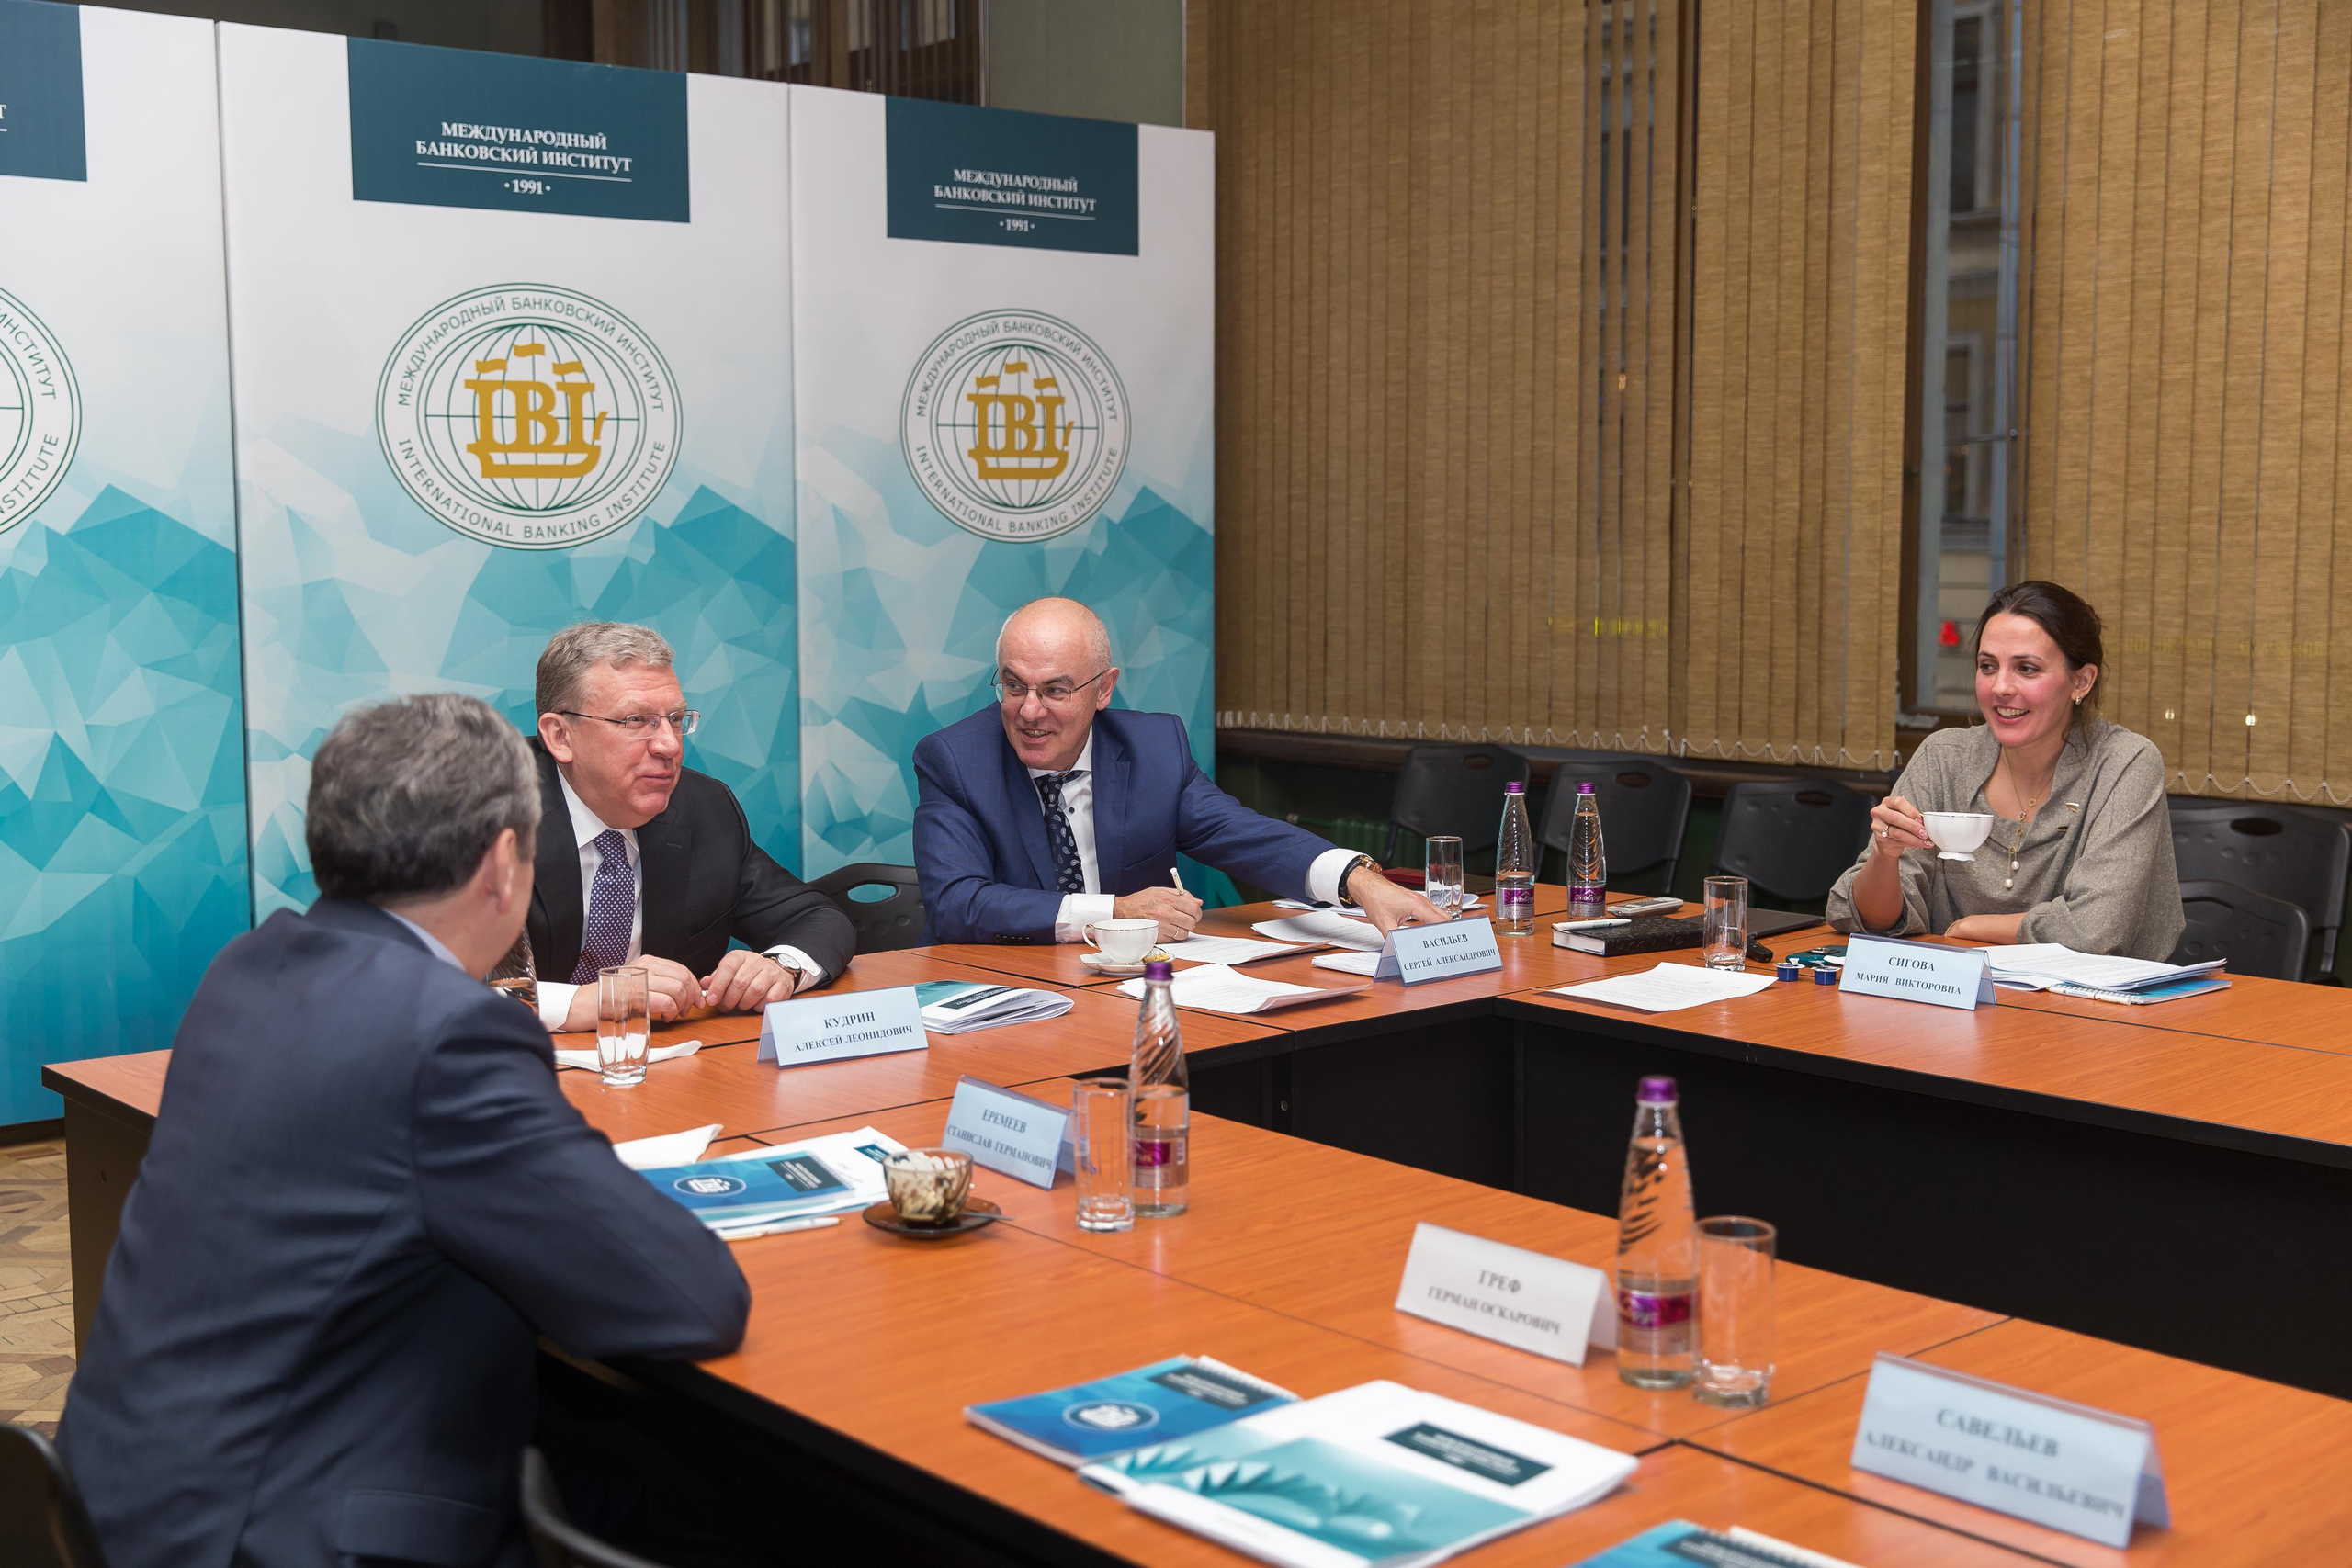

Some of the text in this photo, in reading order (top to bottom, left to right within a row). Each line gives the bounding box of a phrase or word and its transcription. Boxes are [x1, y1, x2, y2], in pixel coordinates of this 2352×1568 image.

[441, 121, 607, 150] МЕЖДУНАРОДНЫЙ
[415, 141, 632, 174] БАНКОВСКИЙ ИНСТИТУТ
[954, 168, 1079, 193] МЕЖДУНАРОДНЫЙ
[933, 185, 1096, 214] БАНКОВСКИЙ ИНСТИТУТ
[398, 296, 665, 412] МЕЖДУНАРОДНЫЙ БАНКОВСКИЙ ИНСТИТУТ
[916, 321, 1118, 421] МЕЖДУНАРОДНЫЙ БАНКОВСКИЙ ИНСТИТУТ
[398, 439, 666, 539] INTERNATIONAL BANKING INSTITUTE
[916, 446, 1118, 533] INTERNATIONAL BANKING INSTITUTE
[1422, 933, 1468, 949] ВАСИЛЬЕВ
[1404, 948, 1497, 971] СЕРГЕЙ АЛЕКСАНДРОВИЧ
[1888, 956, 1935, 972] СИГОВА
[1855, 972, 1962, 995] МАРИЯ ВИКТОРОВНА
[823, 1011, 876, 1030] КУДРИН
[795, 1024, 913, 1052] АЛЕКСЕЙ ЛЕОНИДОВИЧ
[982, 1108, 1027, 1134] ЕРЕМЕЕВ
[947, 1124, 1053, 1170] СТАНИСЛАВ ГЕРМАНОВИЧ
[1478, 1269, 1522, 1293] ГРЕФ
[1428, 1285, 1562, 1336] ГЕРМАН ОСКАРОВИЧ
[1937, 1407, 2060, 1458] САВЕЛЬЕВ
[1864, 1430, 2126, 1519] АЛЕКСАНДР ВАСИЛЬЕВИЧ
